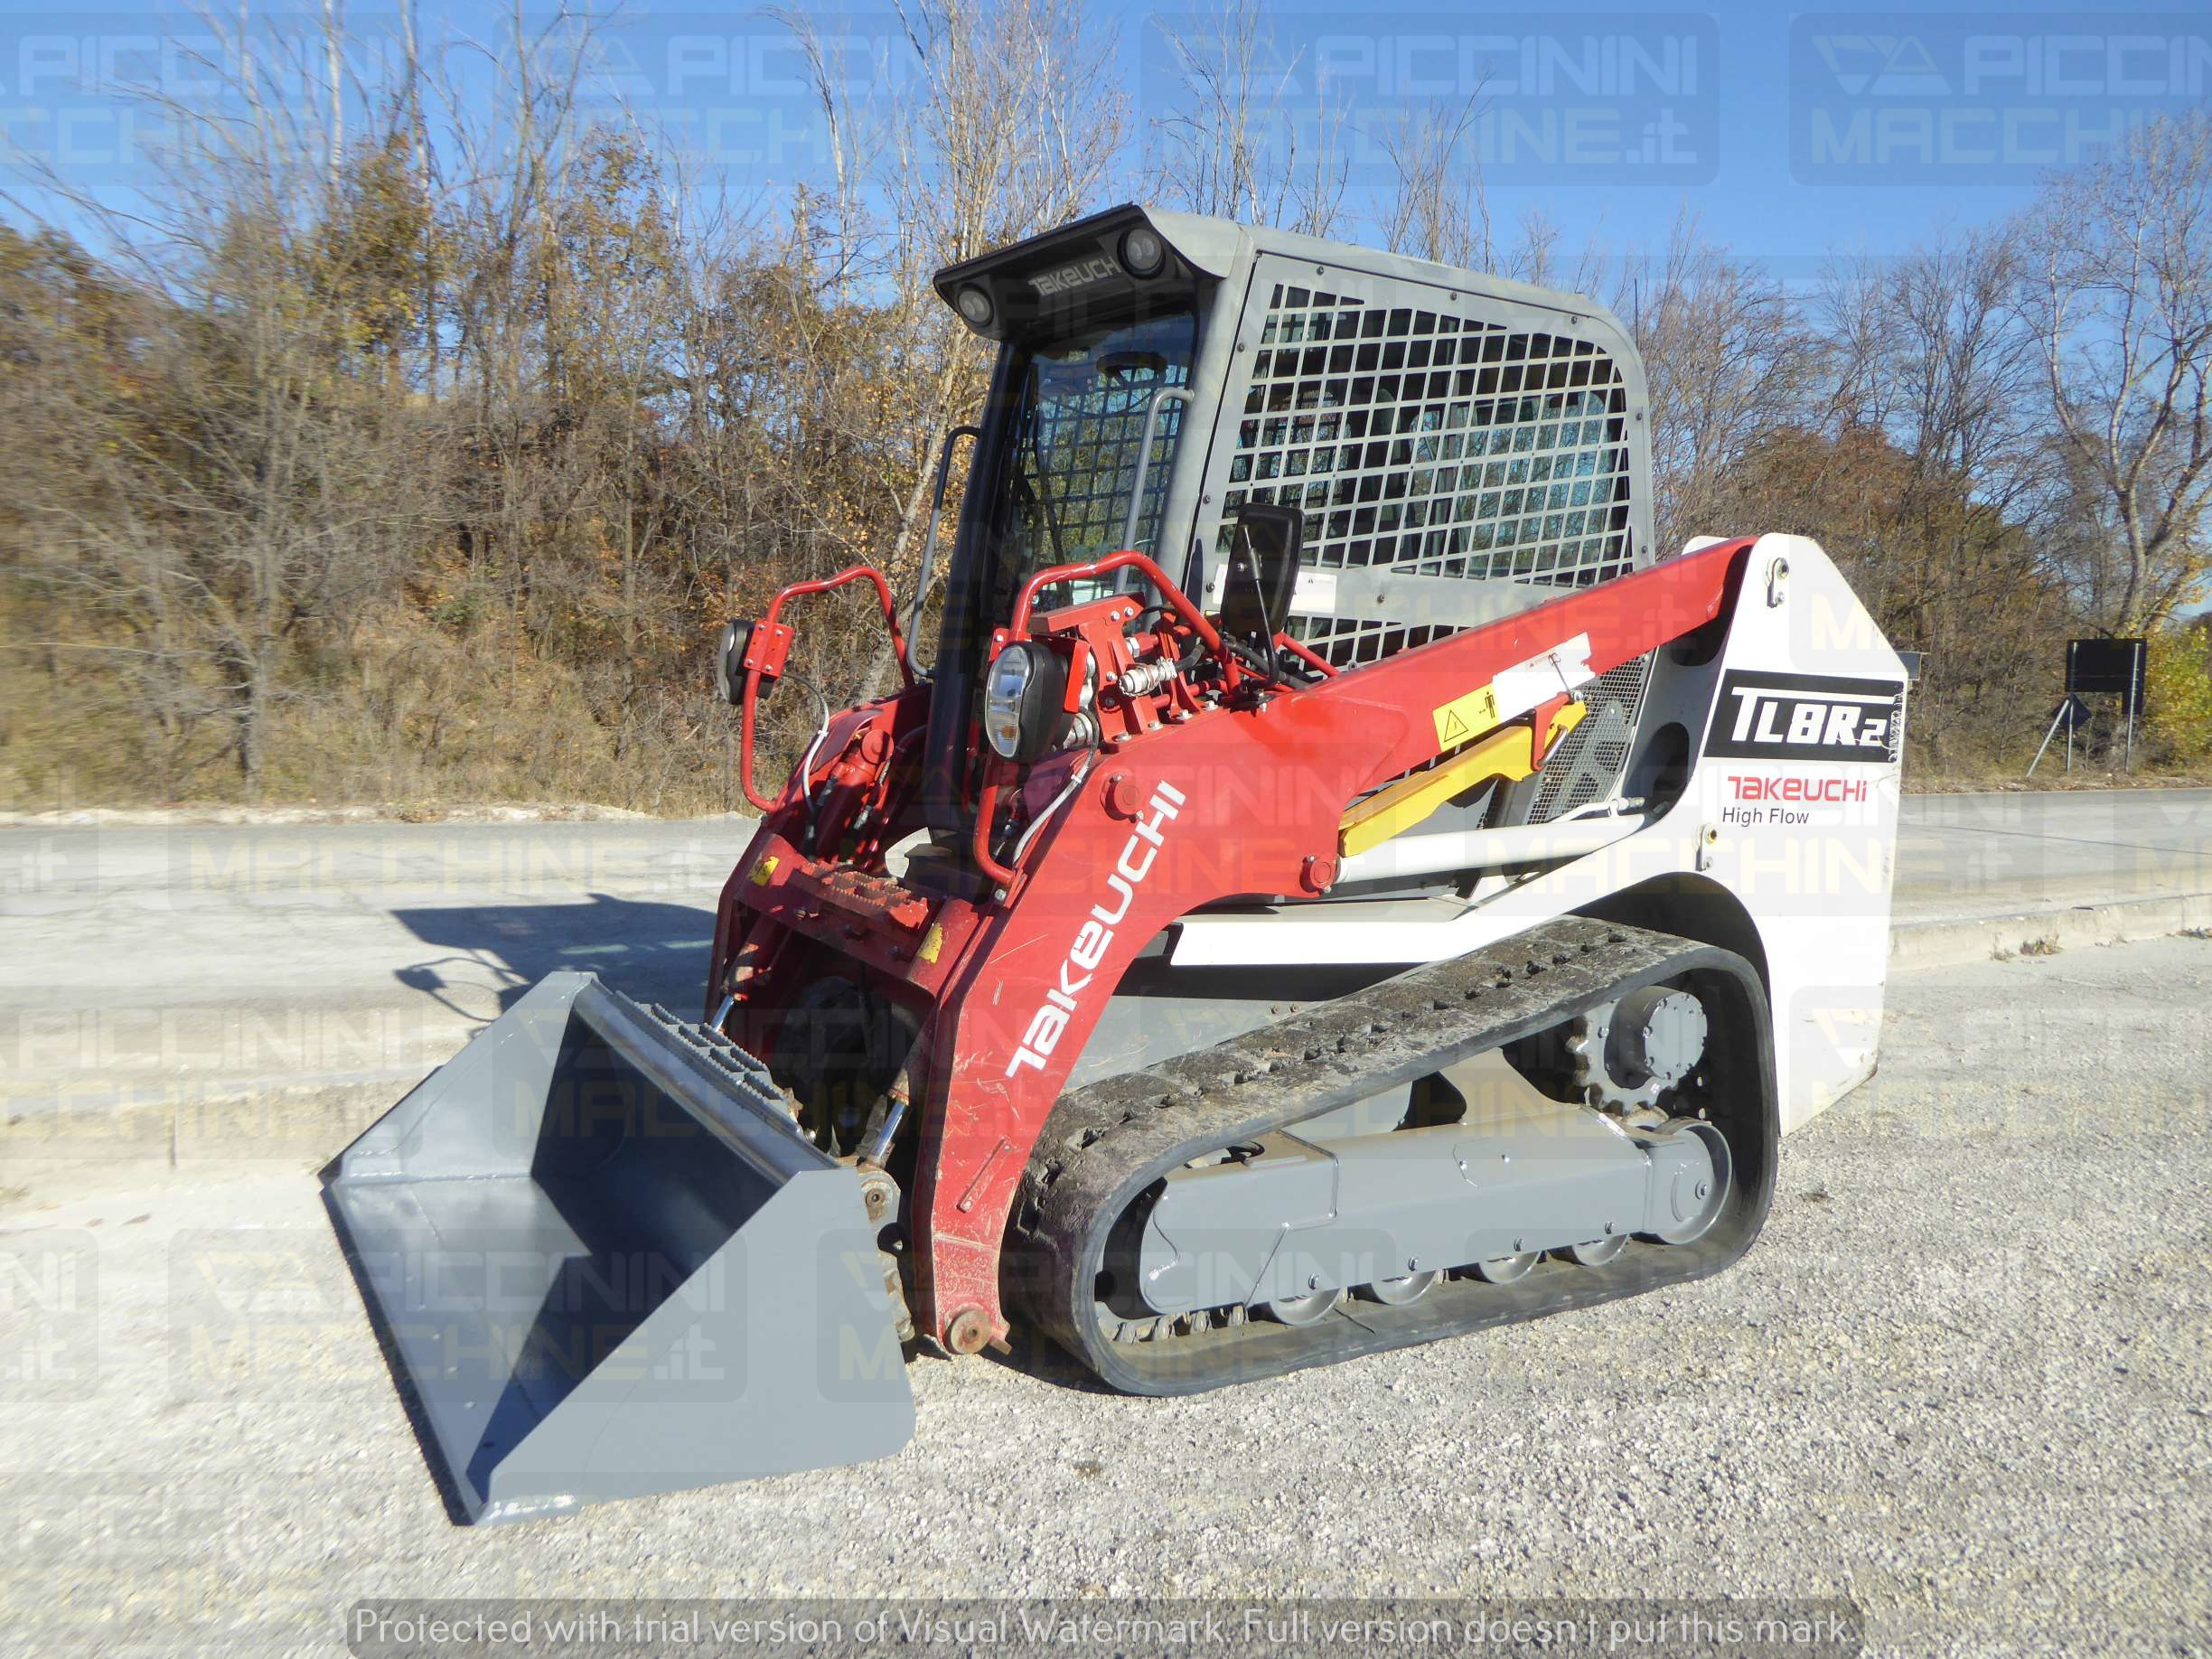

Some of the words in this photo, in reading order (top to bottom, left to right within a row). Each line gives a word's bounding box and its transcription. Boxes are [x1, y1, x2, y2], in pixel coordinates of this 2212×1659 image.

[1028, 256, 1121, 295] TAKEUCH
[1722, 807, 1762, 827] High
[1769, 808, 1809, 824] Flow
